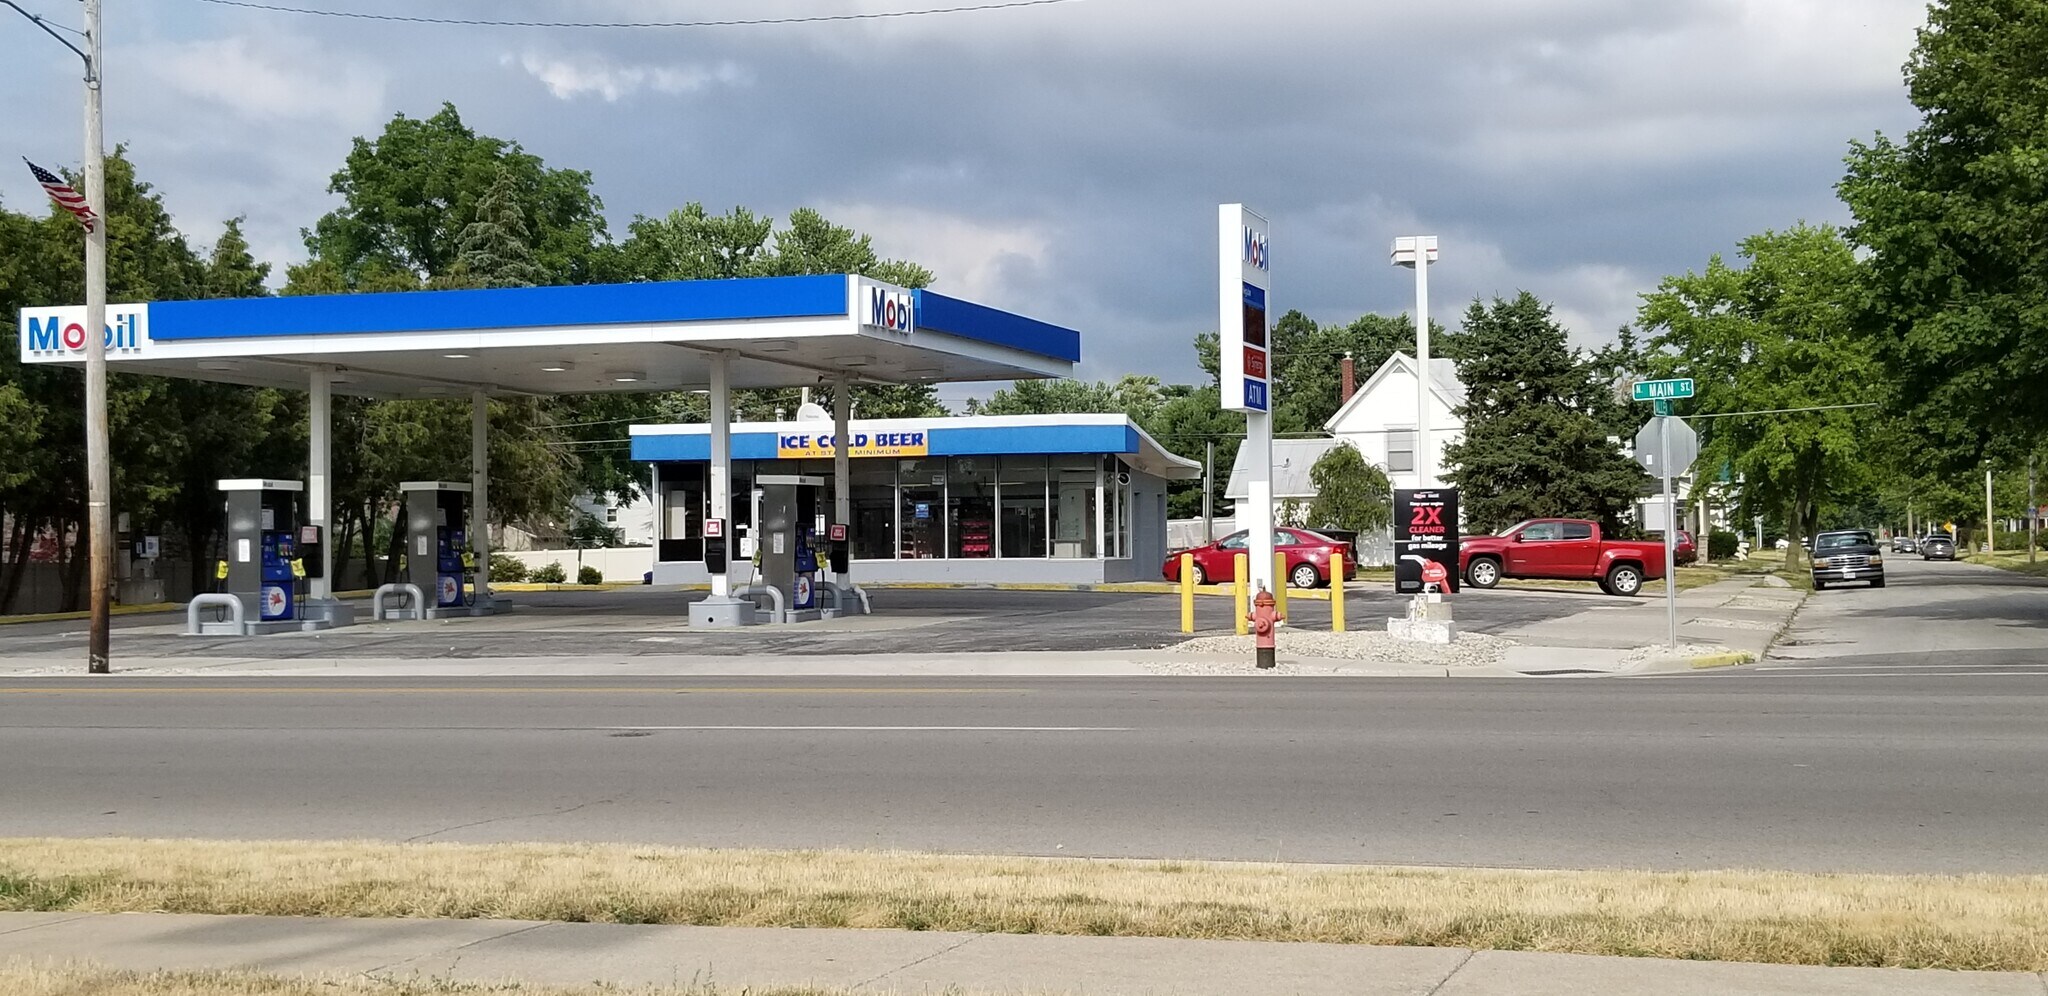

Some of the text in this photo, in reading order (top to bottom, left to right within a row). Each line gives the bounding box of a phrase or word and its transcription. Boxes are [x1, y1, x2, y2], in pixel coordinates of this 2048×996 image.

[1243, 225, 1269, 271] Mobil
[872, 286, 916, 334] Mobil
[1248, 383, 1262, 405] ATM
[1649, 382, 1674, 397] MAIN
[780, 434, 810, 449] ICE
[875, 432, 923, 447] BEER
[1411, 507, 1442, 524] 2X
